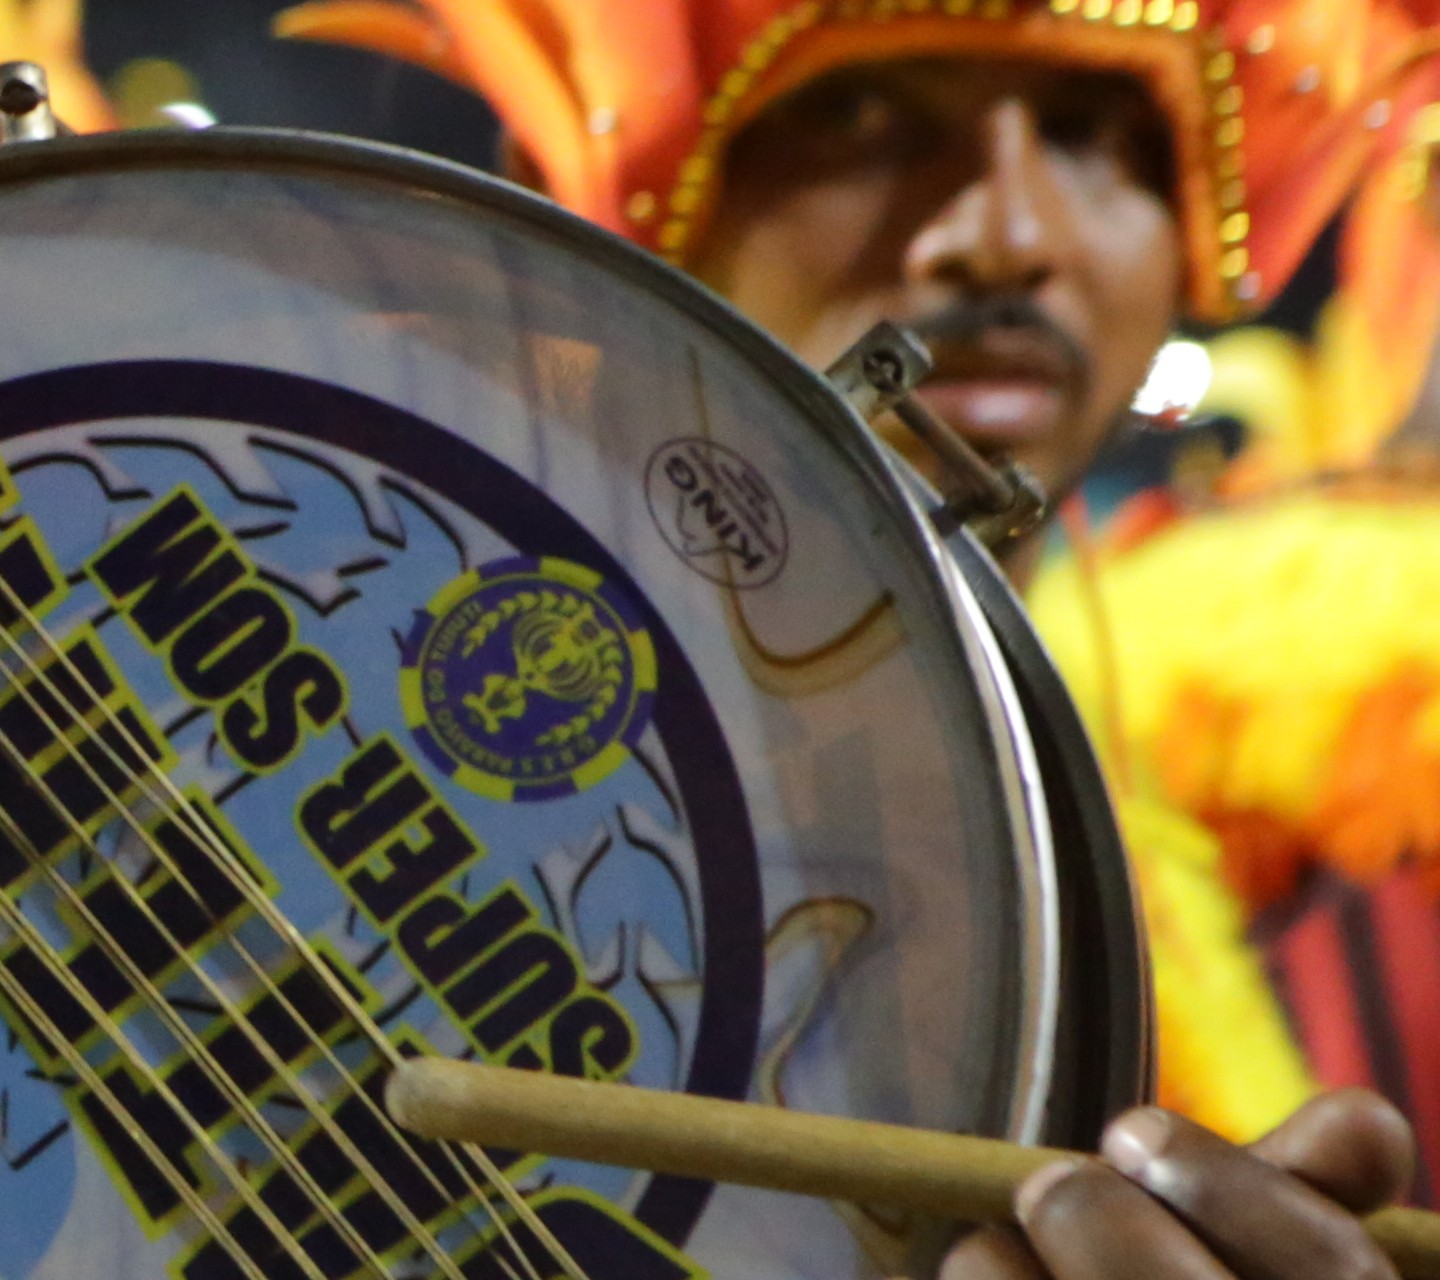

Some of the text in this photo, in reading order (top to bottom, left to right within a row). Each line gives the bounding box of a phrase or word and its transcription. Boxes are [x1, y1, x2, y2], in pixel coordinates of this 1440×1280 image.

[664, 456, 766, 573] KING
[83, 480, 640, 1082] SUPER SOM
